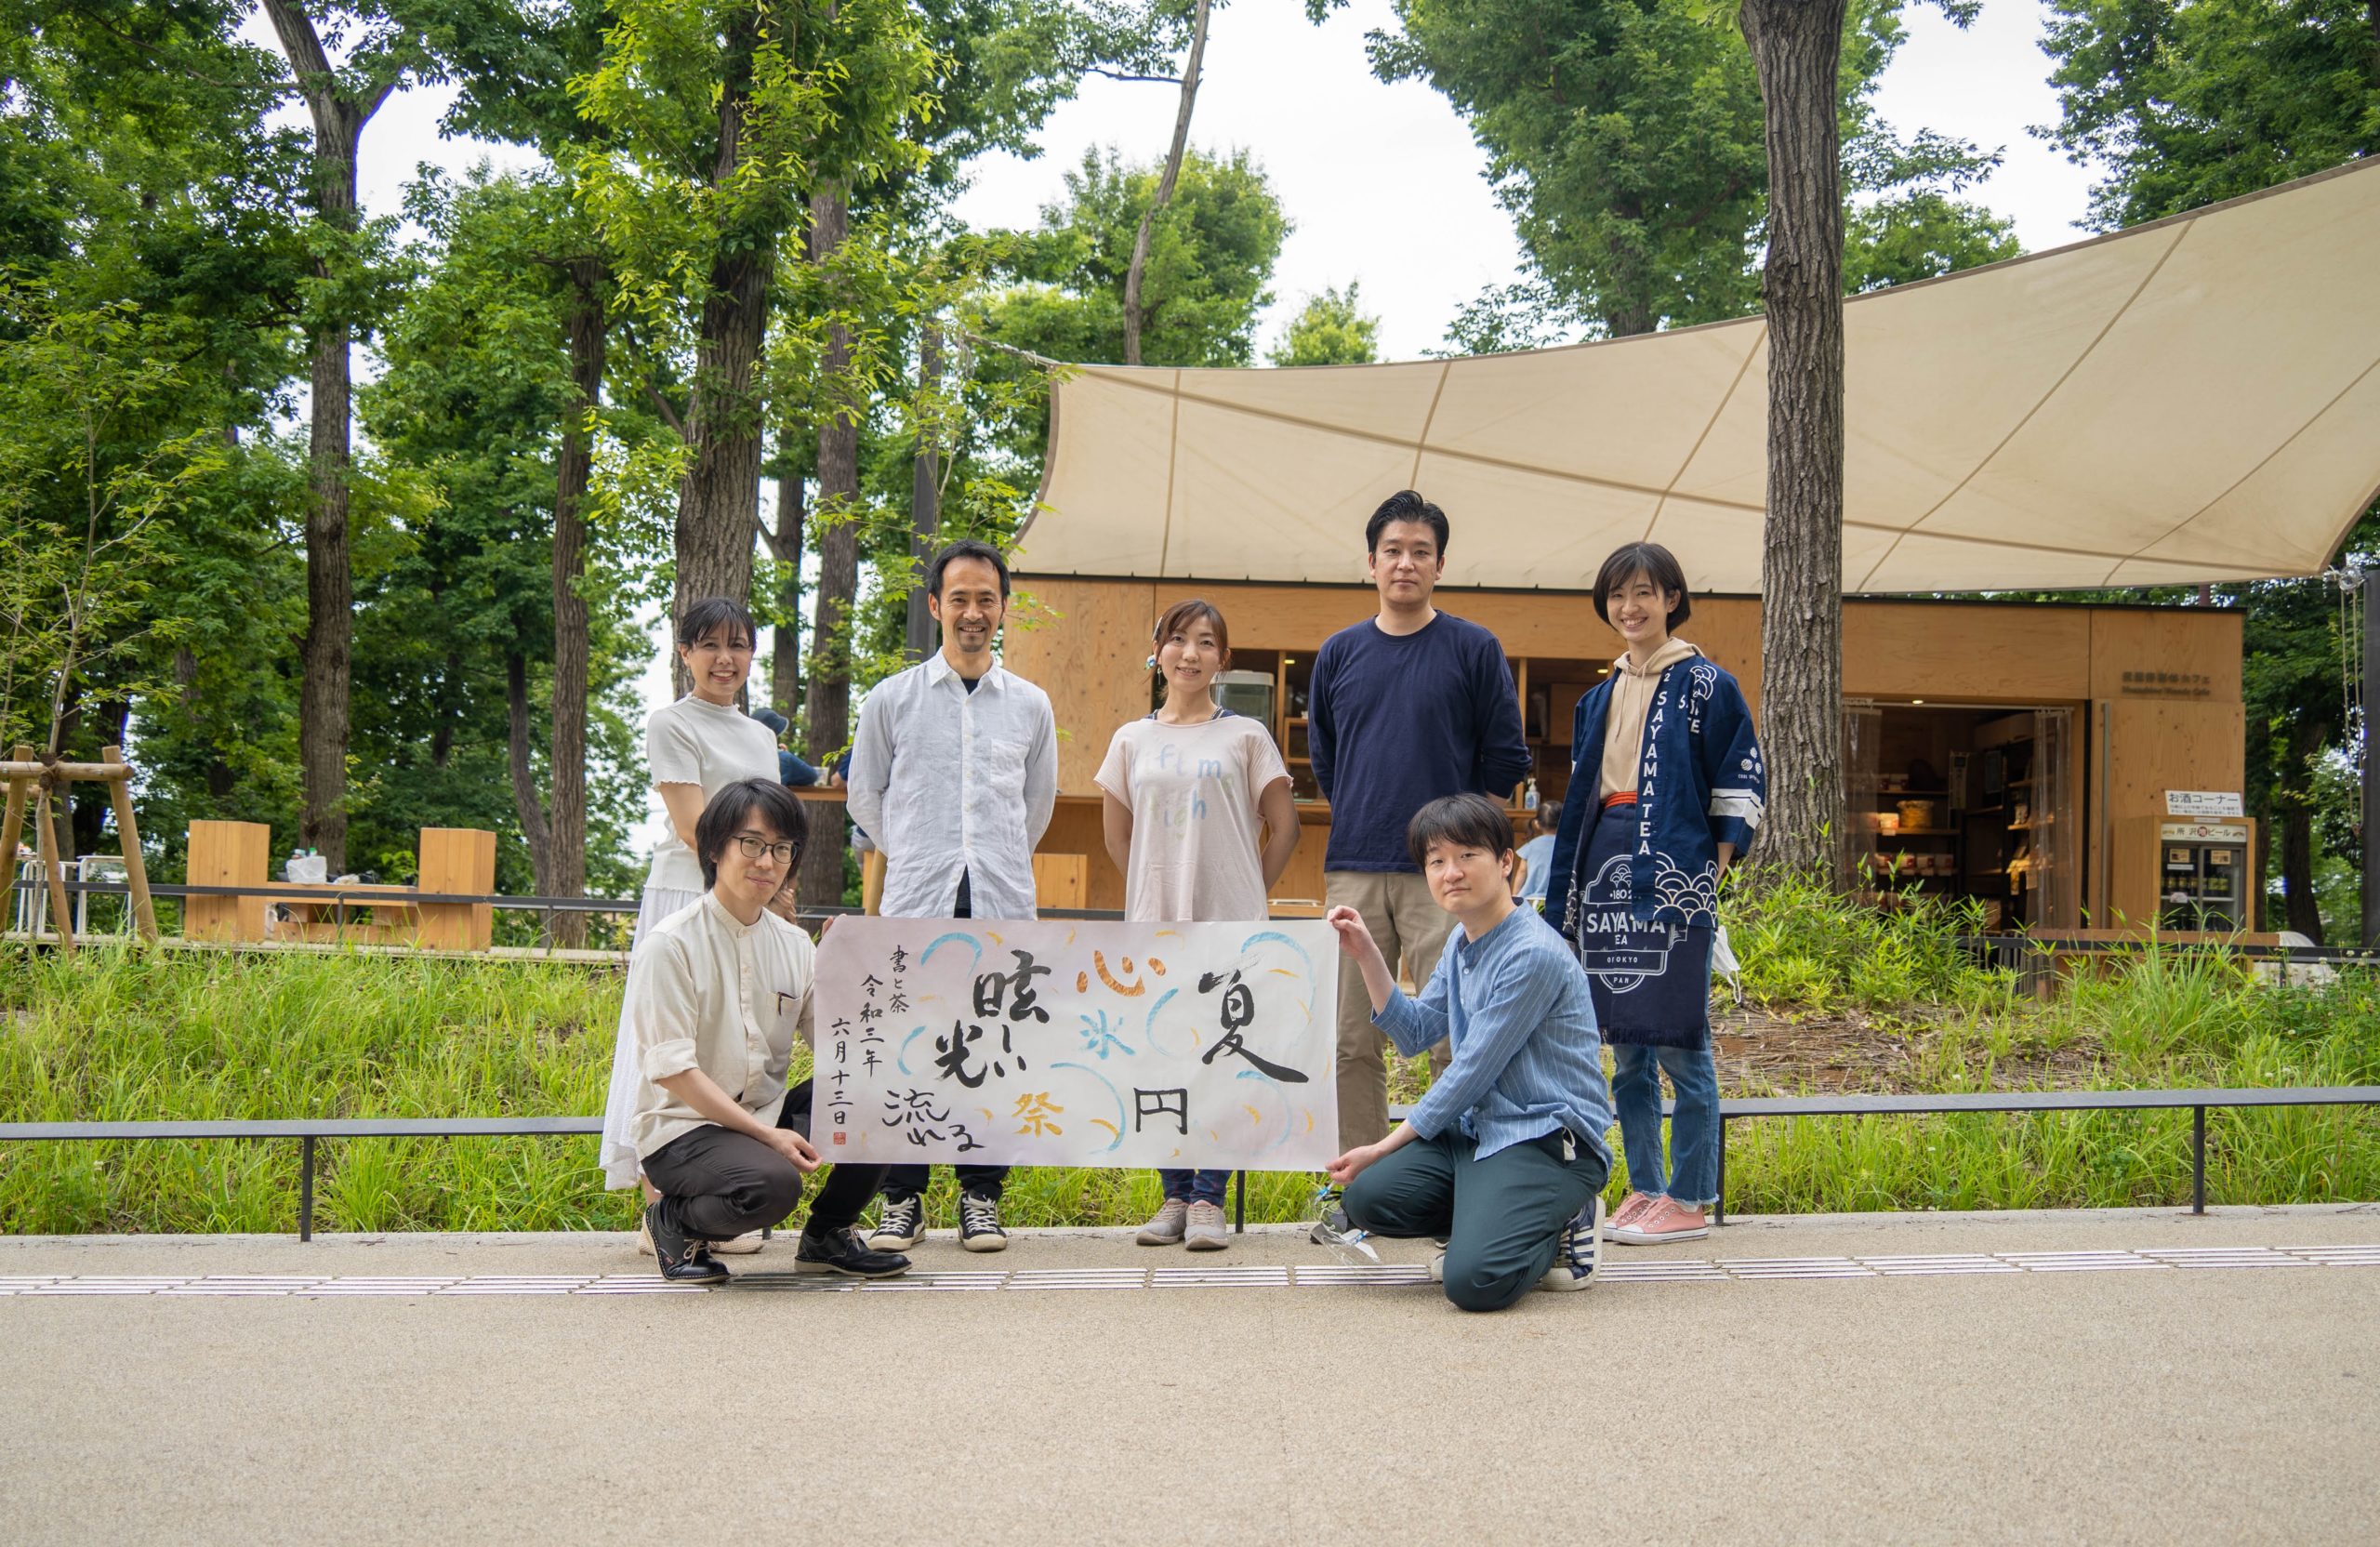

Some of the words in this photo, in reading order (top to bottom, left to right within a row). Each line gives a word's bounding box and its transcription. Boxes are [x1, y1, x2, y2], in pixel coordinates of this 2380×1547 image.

[1643, 691, 1668, 797] SAYAMA
[1638, 803, 1653, 855] TEA
[2168, 792, 2239, 805] お酒コーナー
[889, 945, 910, 1014] 書と茶
[1076, 950, 1167, 998] 心
[859, 973, 885, 1078] 令和三年
[1197, 952, 1310, 1083] 夏
[827, 1017, 853, 1125] 六月十三日
[881, 1088, 985, 1153] 流れる
[1011, 1091, 1064, 1138] 祭
[1132, 1087, 1188, 1136] 円
